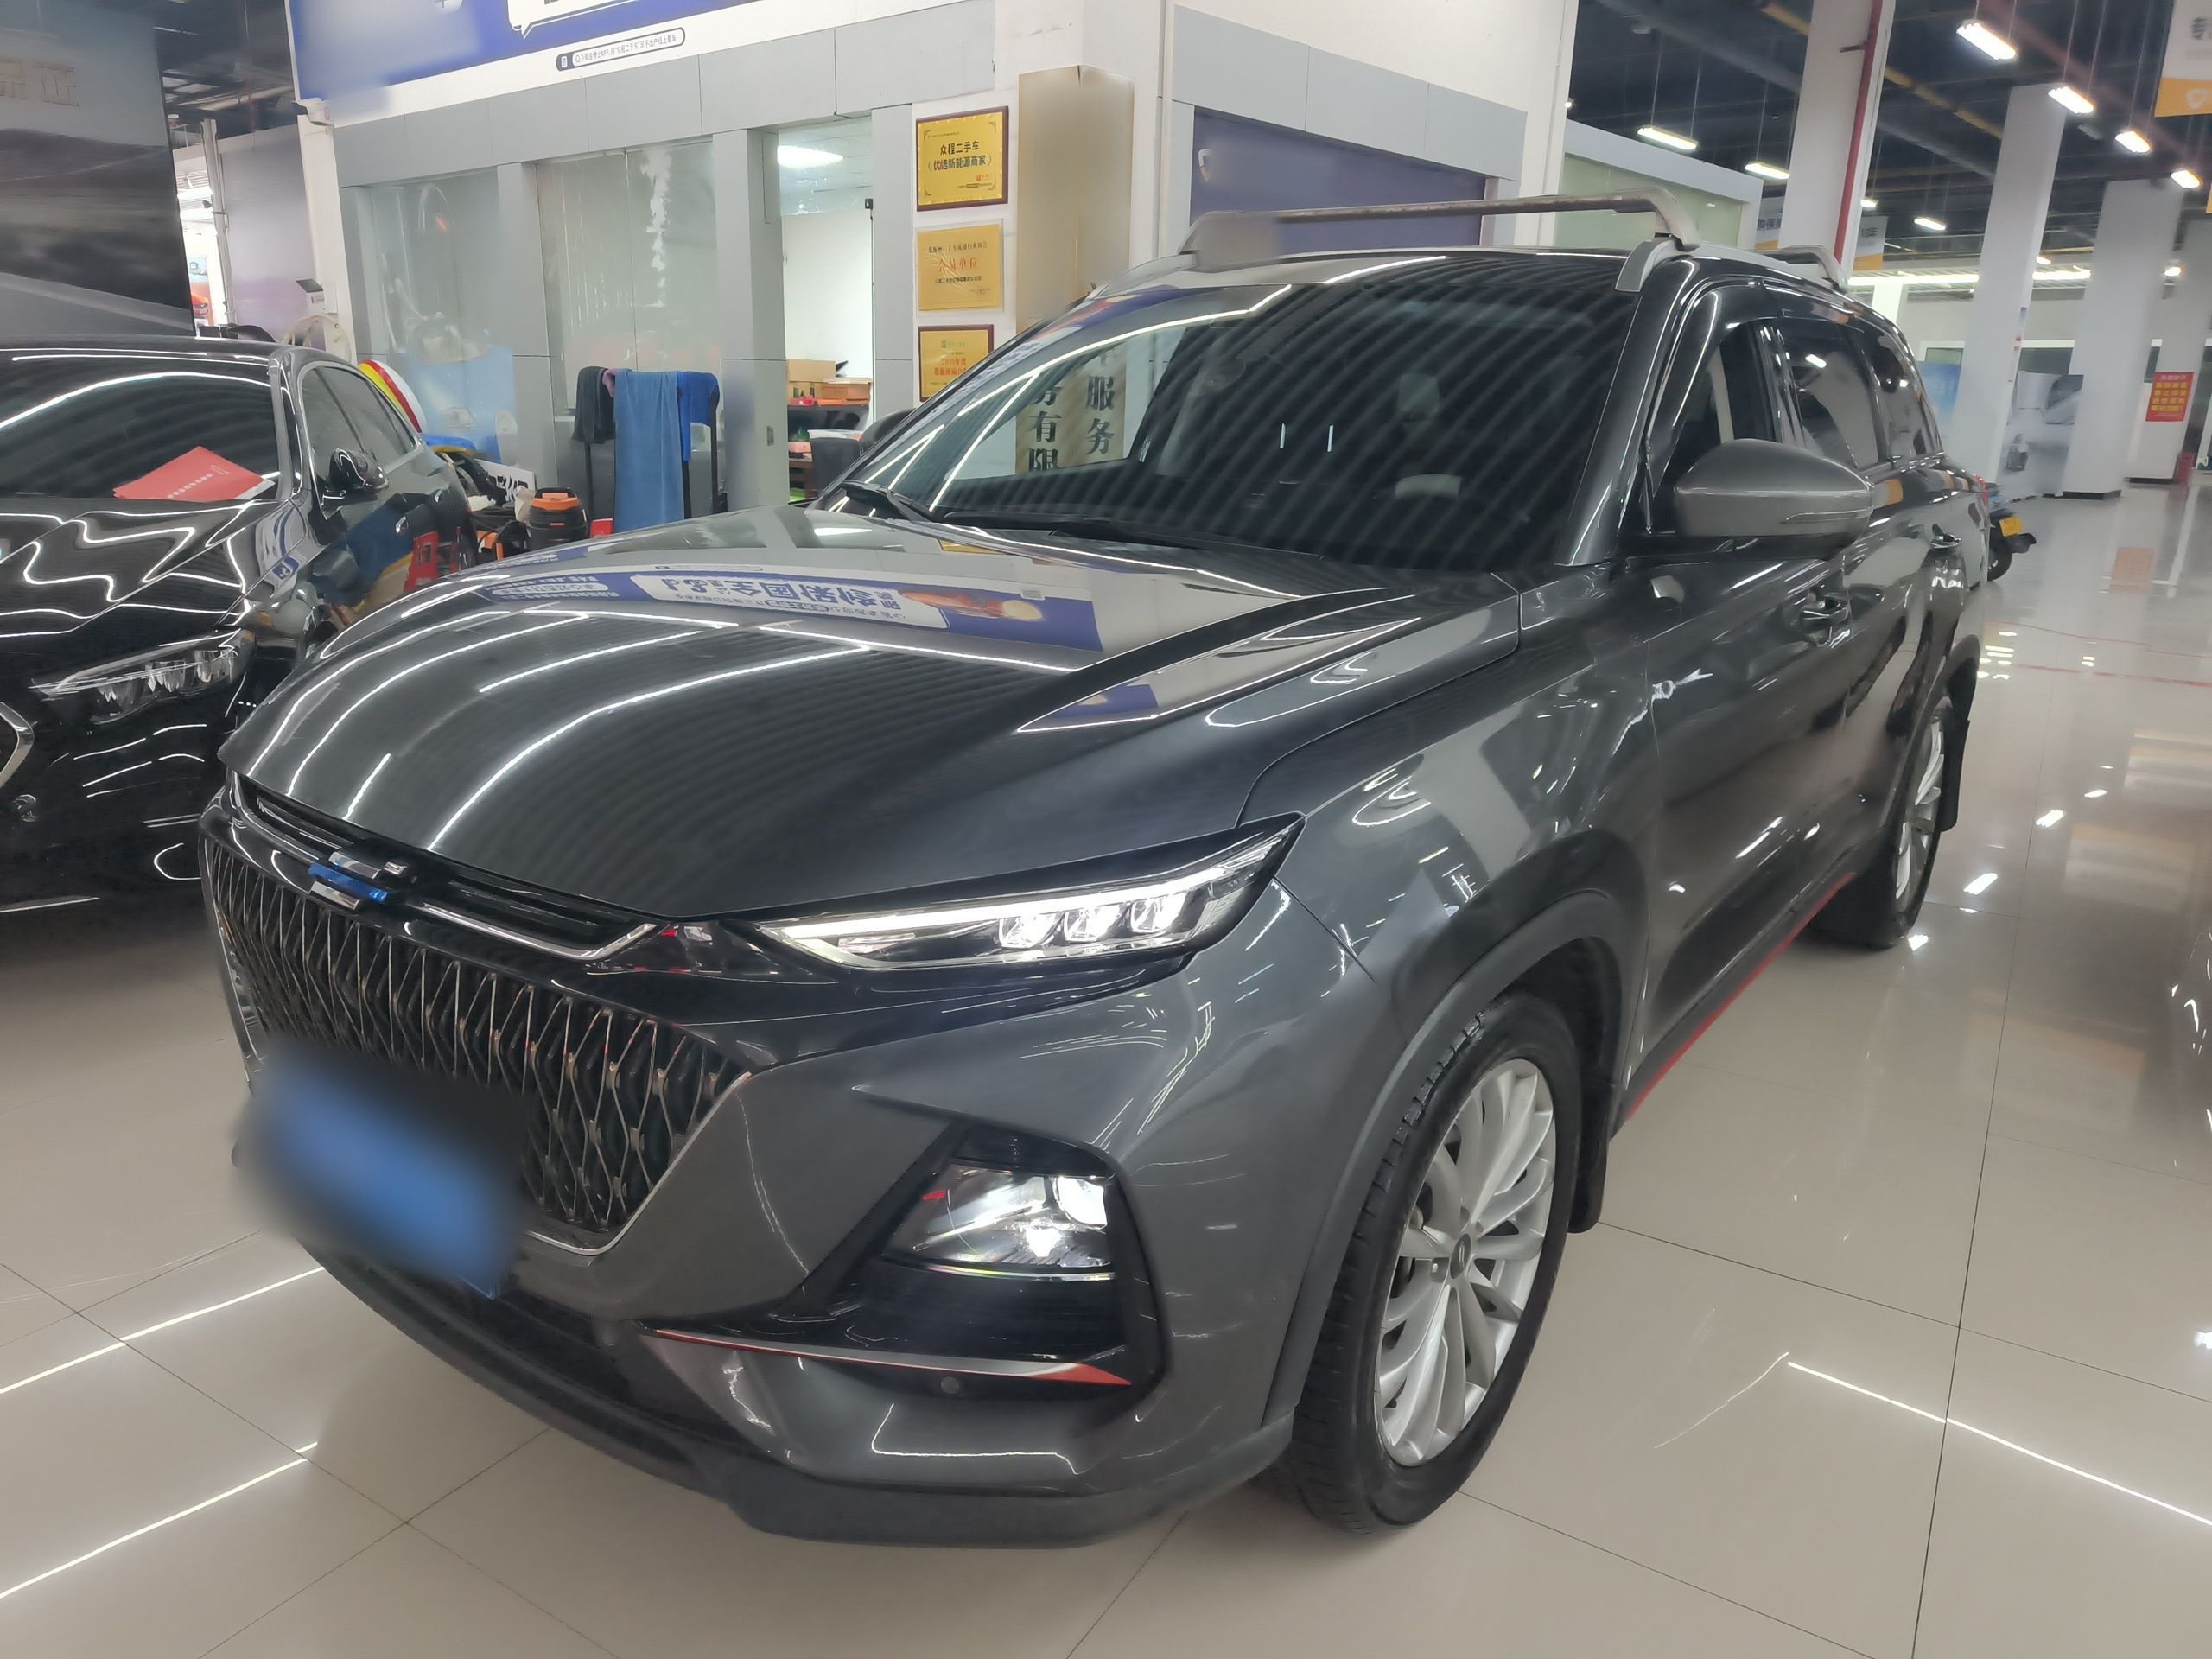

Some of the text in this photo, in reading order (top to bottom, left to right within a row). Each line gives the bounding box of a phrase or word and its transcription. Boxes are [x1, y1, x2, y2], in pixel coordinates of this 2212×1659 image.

[940, 141, 980, 156] 众程二手车
[939, 257, 978, 271] 会员单位
[1086, 353, 1116, 455] 服务
